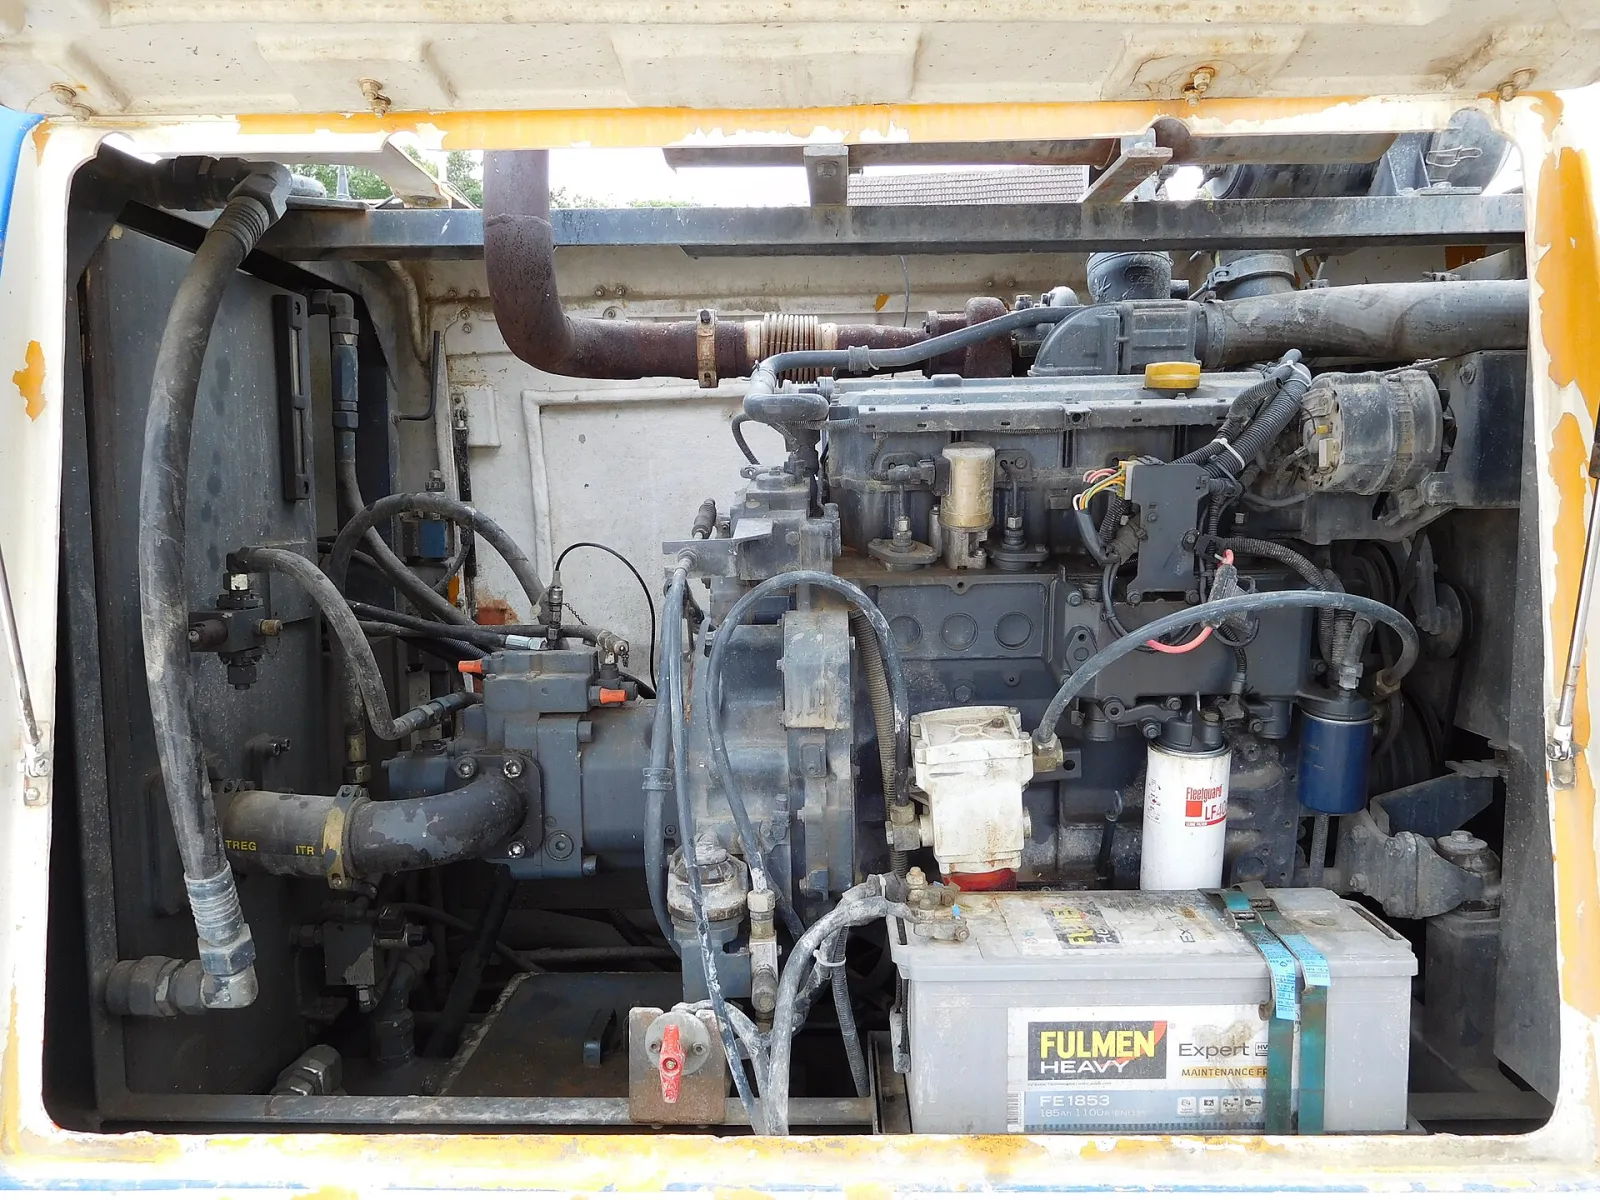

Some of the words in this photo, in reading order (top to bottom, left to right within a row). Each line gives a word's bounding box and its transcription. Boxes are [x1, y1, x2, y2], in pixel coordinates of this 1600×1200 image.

[1186, 784, 1224, 802] Fleetguard
[295, 845, 315, 856] ITR
[1040, 1030, 1155, 1058] FULMEN
[1178, 1043, 1250, 1059] Expert
[1040, 1060, 1130, 1073] HEAVY
[1181, 1067, 1254, 1077] MAINTENANCE
